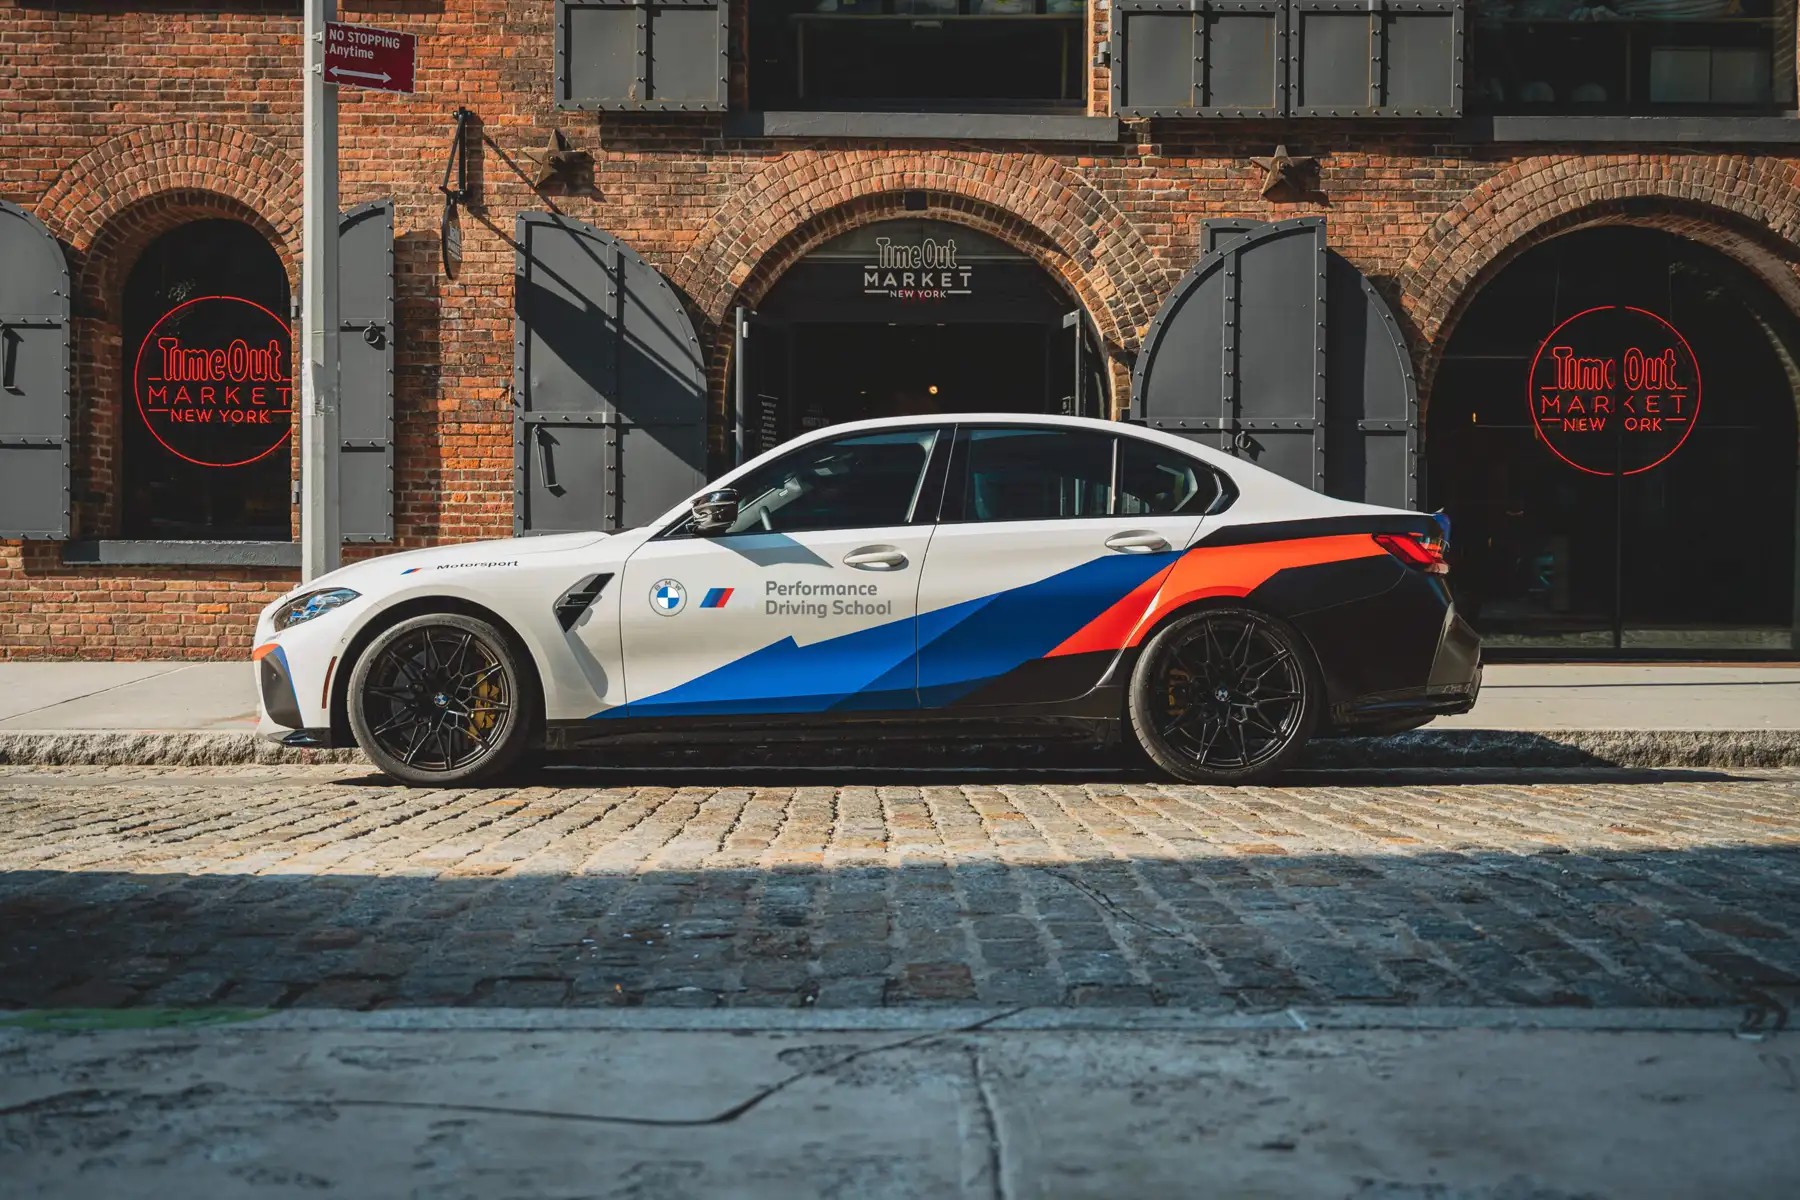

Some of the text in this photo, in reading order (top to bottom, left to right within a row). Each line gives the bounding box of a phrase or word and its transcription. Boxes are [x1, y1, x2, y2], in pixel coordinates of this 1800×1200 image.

[329, 29, 400, 49] NO STOPPING
[329, 43, 374, 59] Anytime
[864, 272, 972, 287] MARKET
[890, 290, 947, 298] NEW YORK
[1624, 347, 1677, 390] Out
[148, 385, 292, 405] MARKET
[170, 409, 271, 423] NEW YORK
[1564, 417, 1662, 431] NEW ORK
[436, 560, 519, 570] Motorsport
[654, 580, 682, 591] BMW
[765, 580, 878, 596] Performance
[765, 599, 892, 619] Driving School
